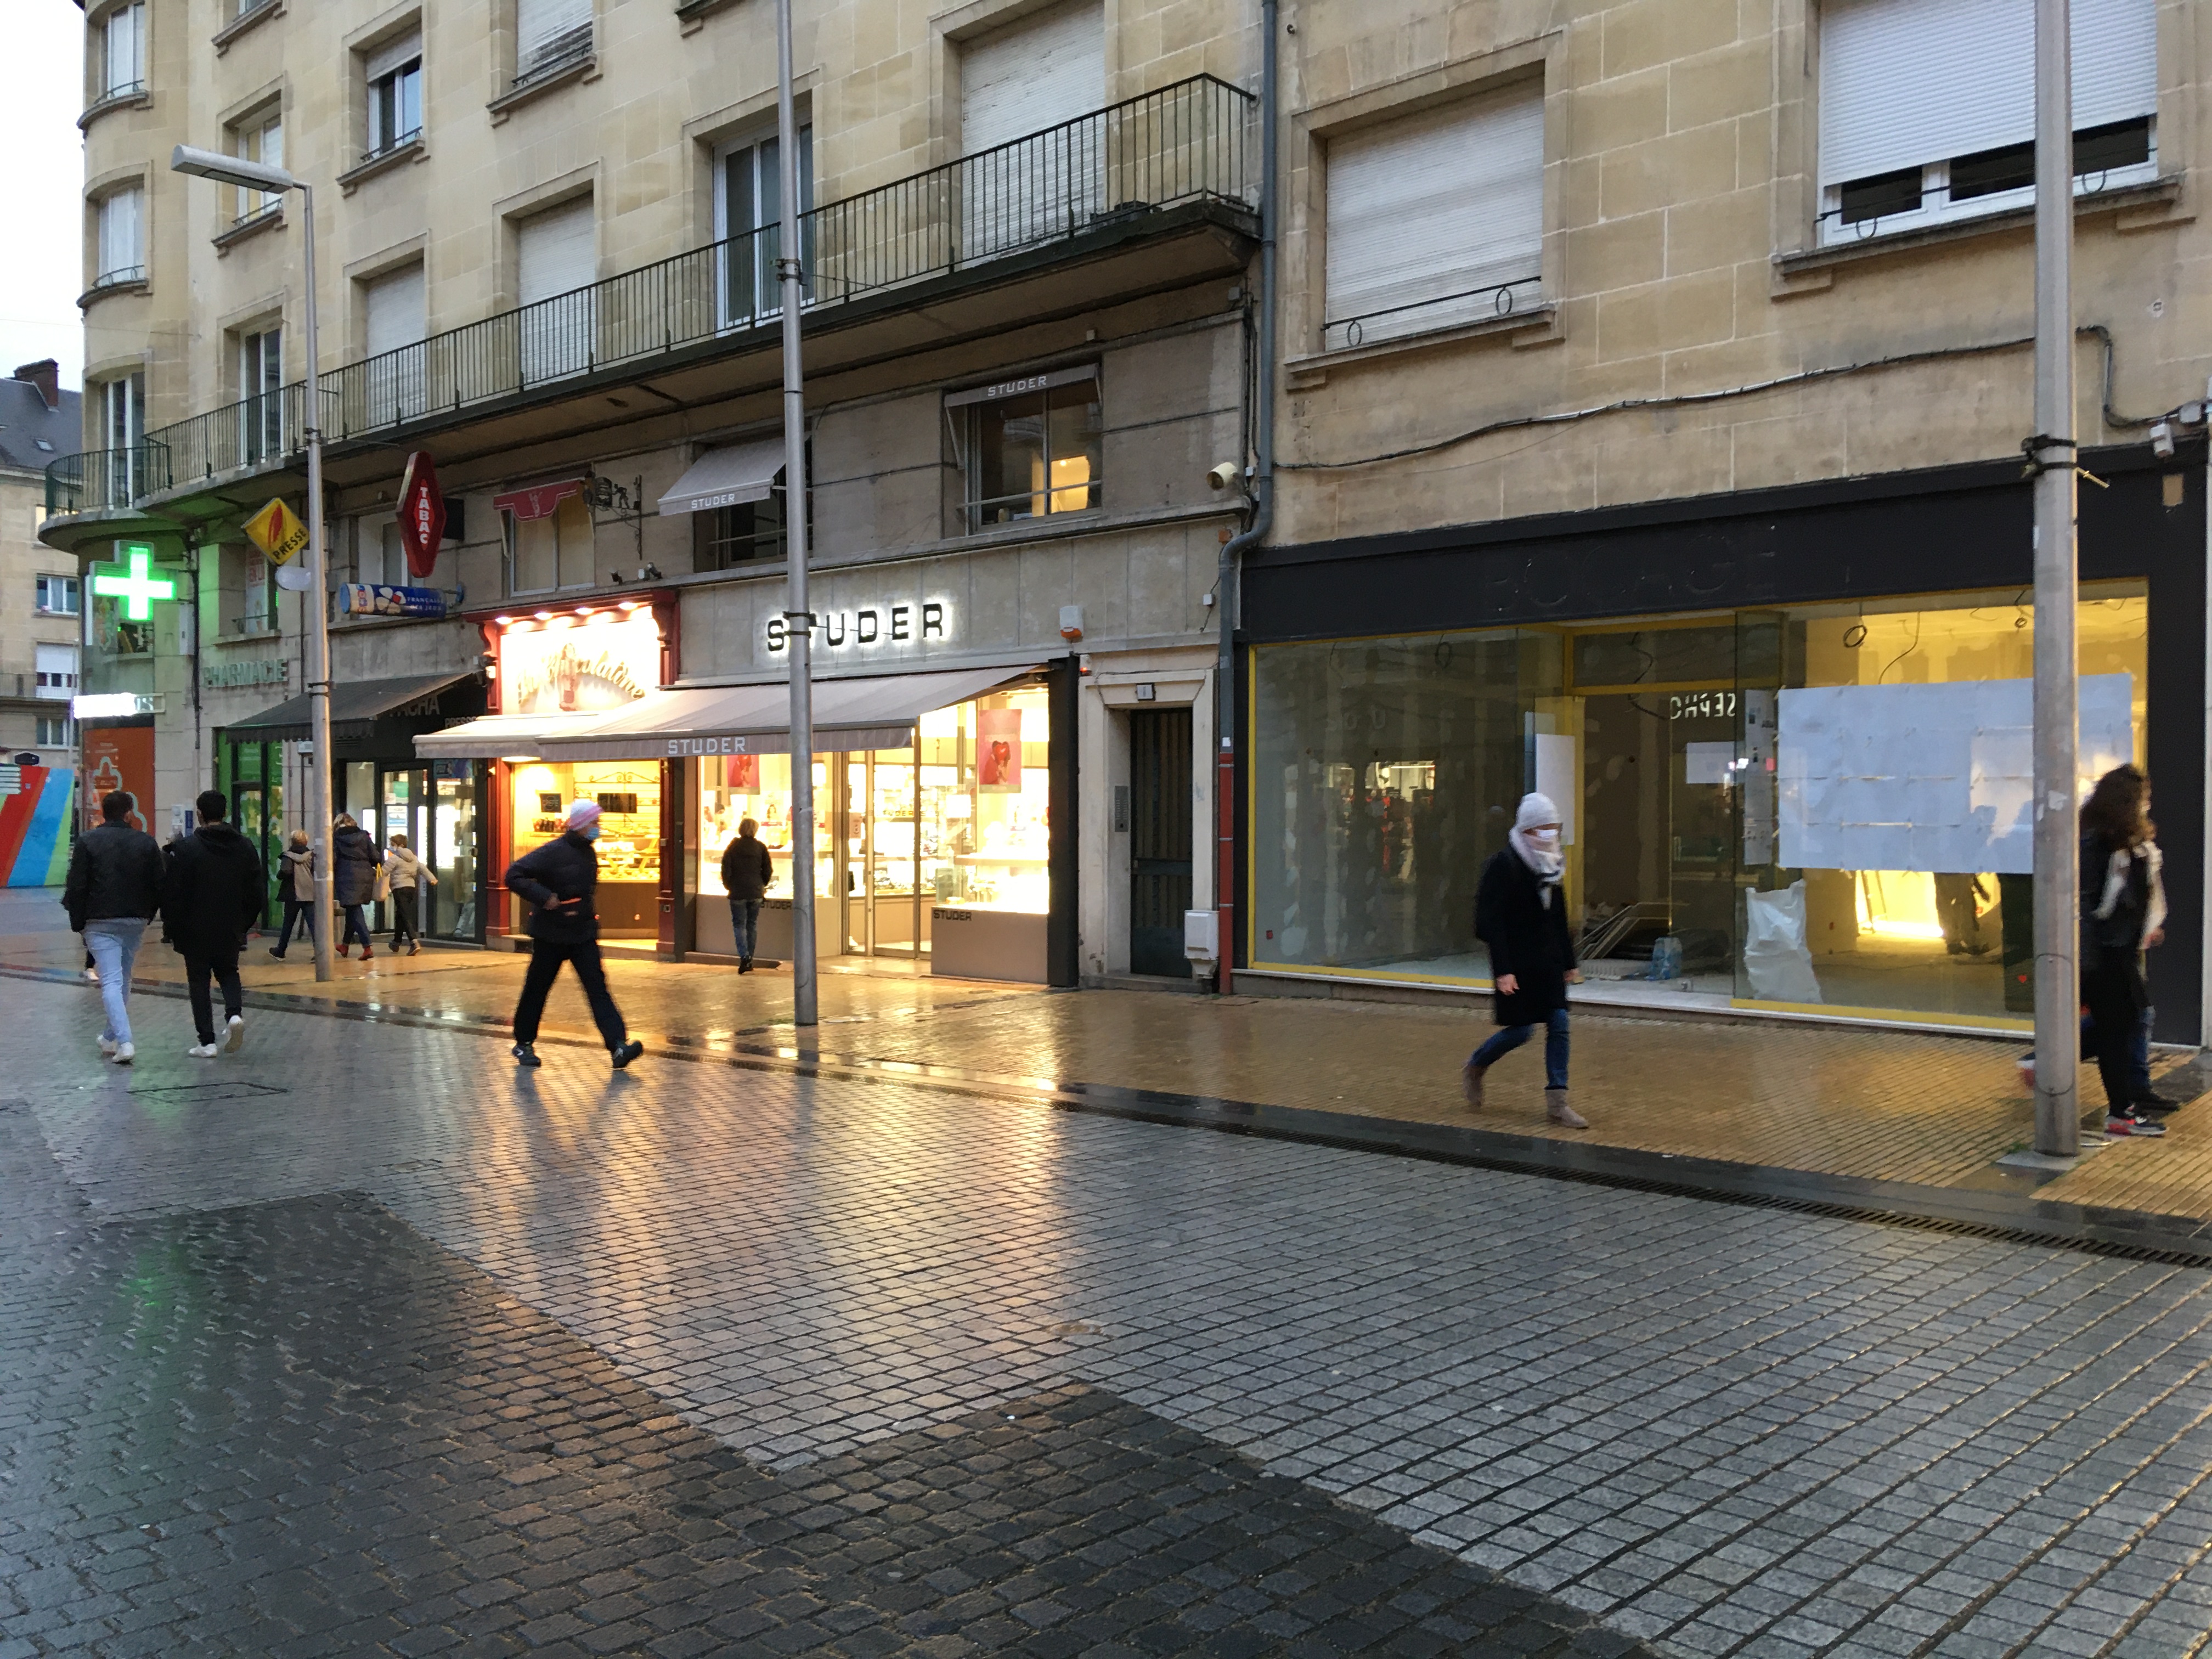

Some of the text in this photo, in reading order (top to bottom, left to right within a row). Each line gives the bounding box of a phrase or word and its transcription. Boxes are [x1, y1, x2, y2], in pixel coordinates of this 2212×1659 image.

[988, 376, 1047, 396] STUDER
[691, 493, 735, 509] STUDER
[419, 486, 430, 544] TABAC
[272, 528, 307, 560] PRESSE
[768, 603, 943, 652] SUDER
[202, 658, 289, 688] PHARMACIE
[668, 737, 746, 754] STUDER
[933, 909, 972, 921] STUDER
